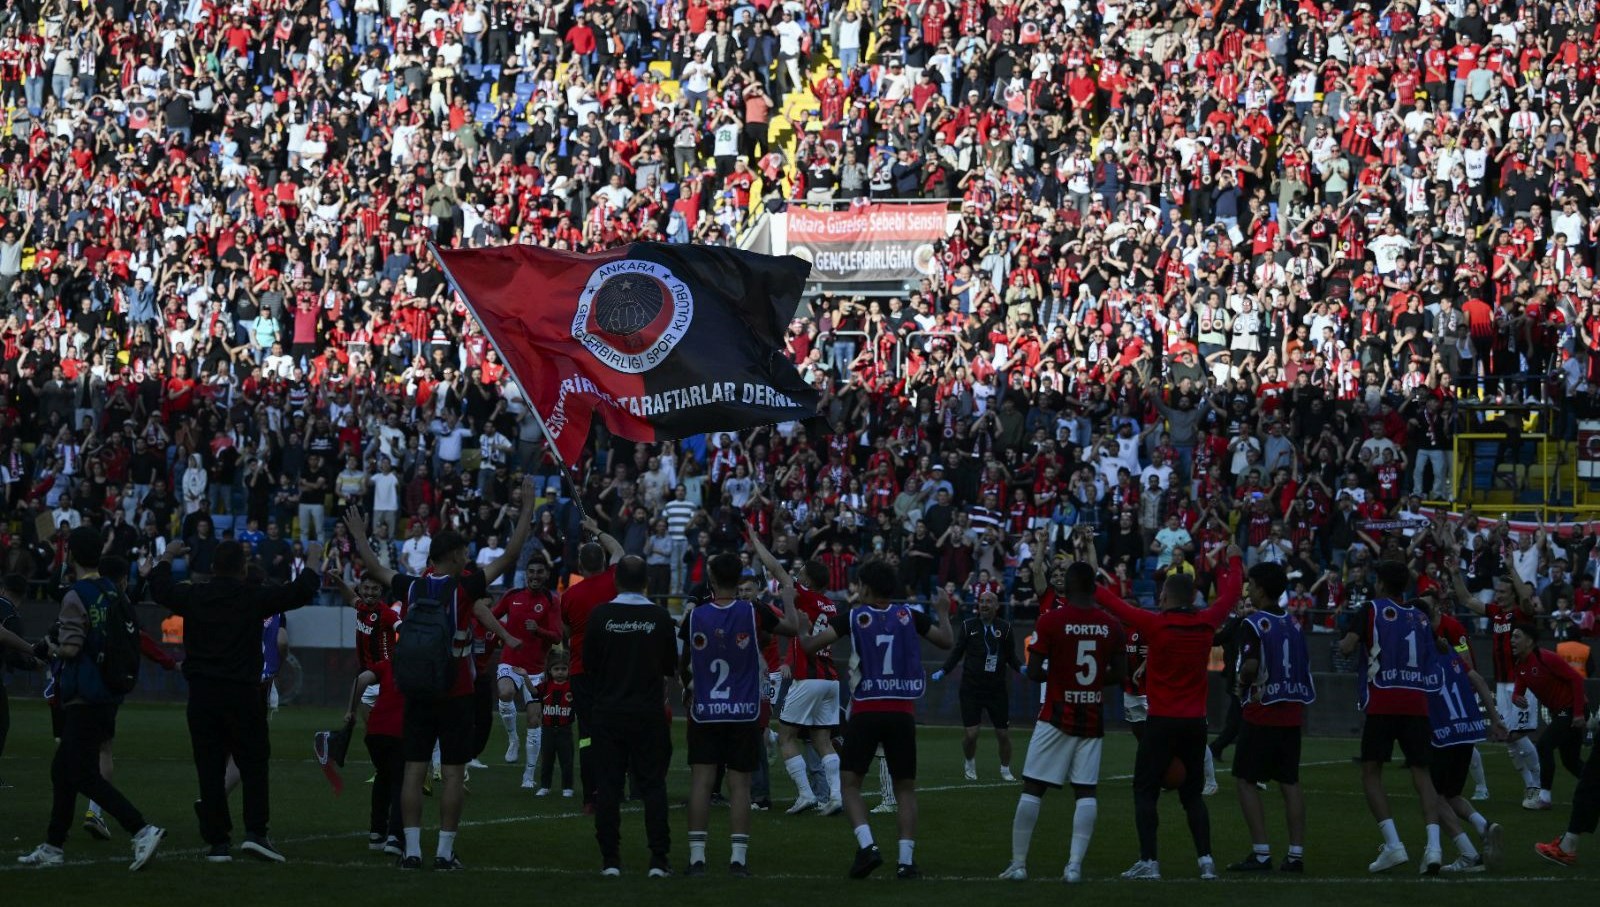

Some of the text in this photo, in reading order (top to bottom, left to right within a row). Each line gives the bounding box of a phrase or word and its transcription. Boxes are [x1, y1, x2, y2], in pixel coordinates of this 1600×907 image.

[789, 211, 942, 234] Ankara Güzelse Sebebi Sensin
[599, 262, 655, 279] ANKARA
[815, 245, 912, 274] GENÇLERBİRLİĞİM
[647, 333, 677, 364] SPOR
[671, 284, 690, 331] KULÜBÜ
[616, 381, 736, 417] TARAFTARLAR
[1064, 624, 1109, 638] PORTAŞ
[875, 634, 895, 675] 7
[1075, 640, 1098, 686] 5
[1404, 629, 1418, 668] 1
[709, 658, 731, 700] 2
[1381, 668, 1398, 681] TOP
[1064, 690, 1102, 704] ETEBO
[1440, 682, 1468, 721] 11
[1518, 711, 1529, 724] 23
